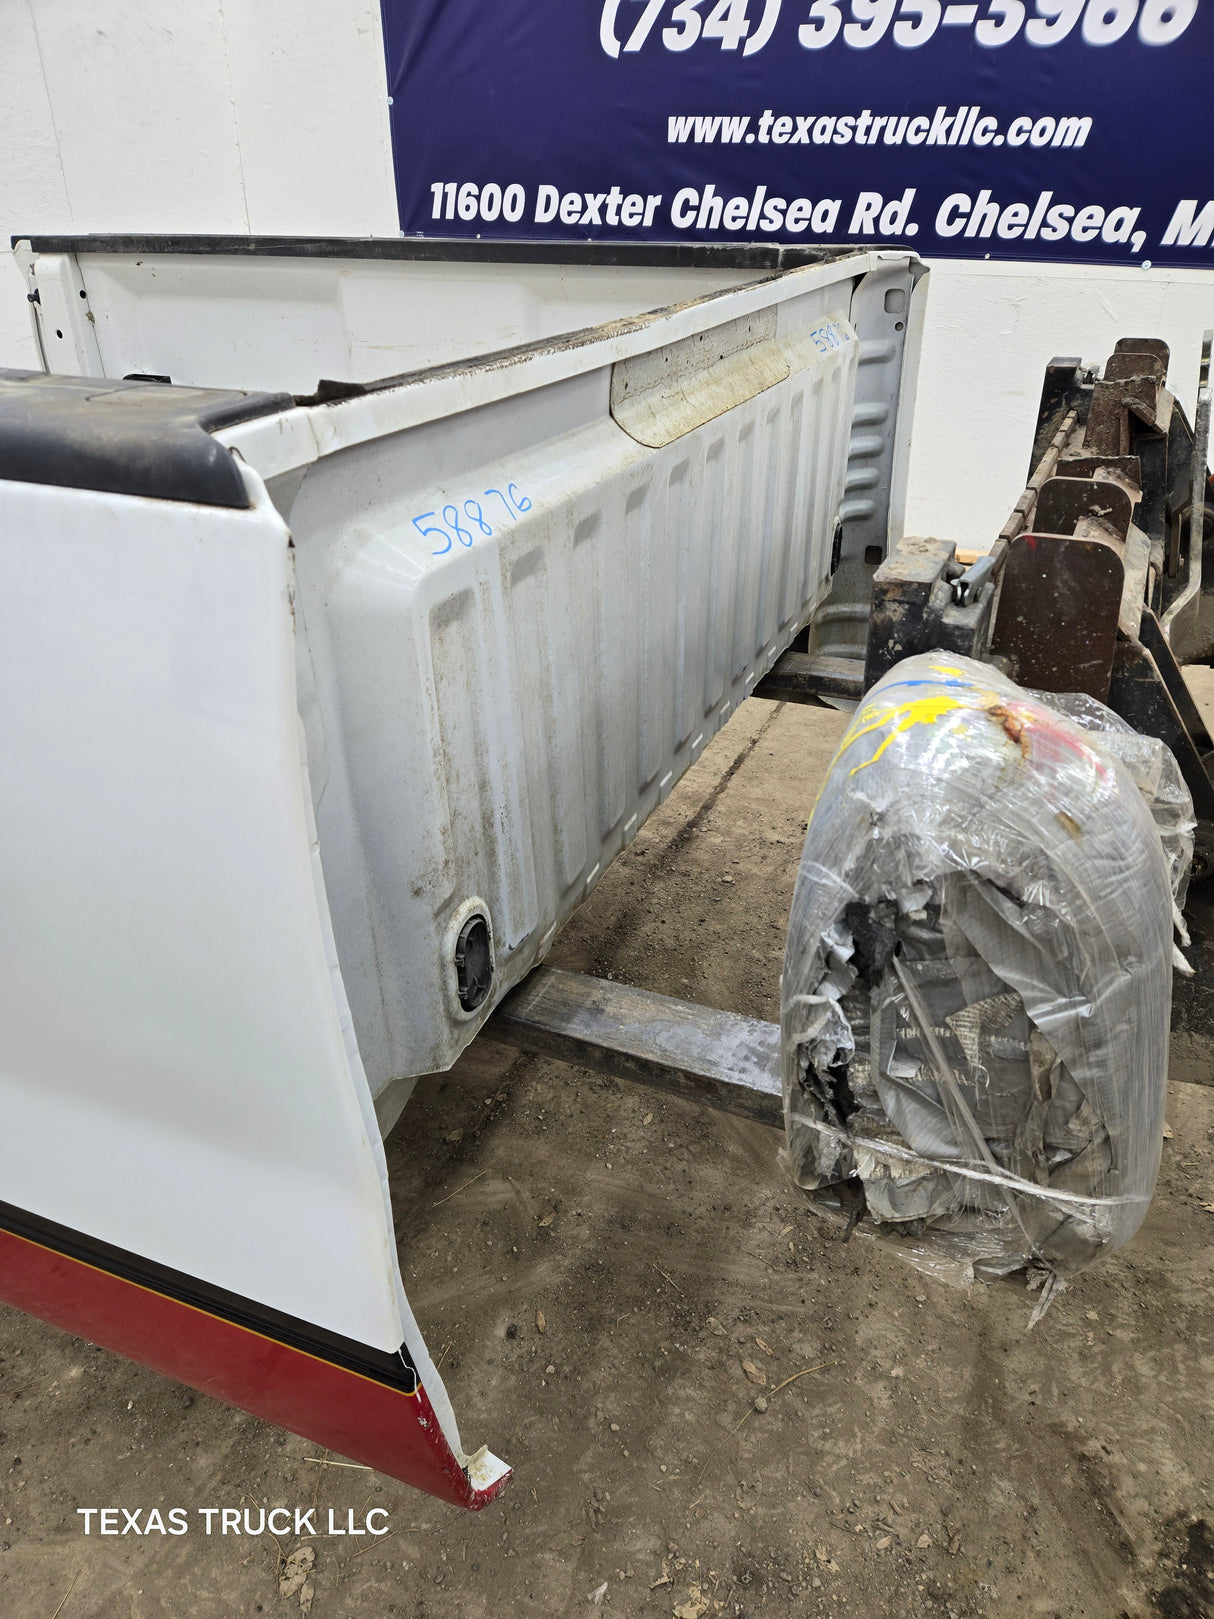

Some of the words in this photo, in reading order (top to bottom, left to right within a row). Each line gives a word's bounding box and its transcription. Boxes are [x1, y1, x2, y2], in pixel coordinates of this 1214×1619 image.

[600, 0, 782, 58] (734)
[667, 106, 1093, 147] www.texastruckllc.com
[430, 182, 526, 222] 11600
[534, 184, 663, 227] Dexter
[670, 184, 843, 234] Chelsea
[848, 188, 919, 237] Rd.
[935, 189, 1147, 254] Chelsea,
[1159, 199, 1214, 248] M
[412, 483, 532, 555] 58876
